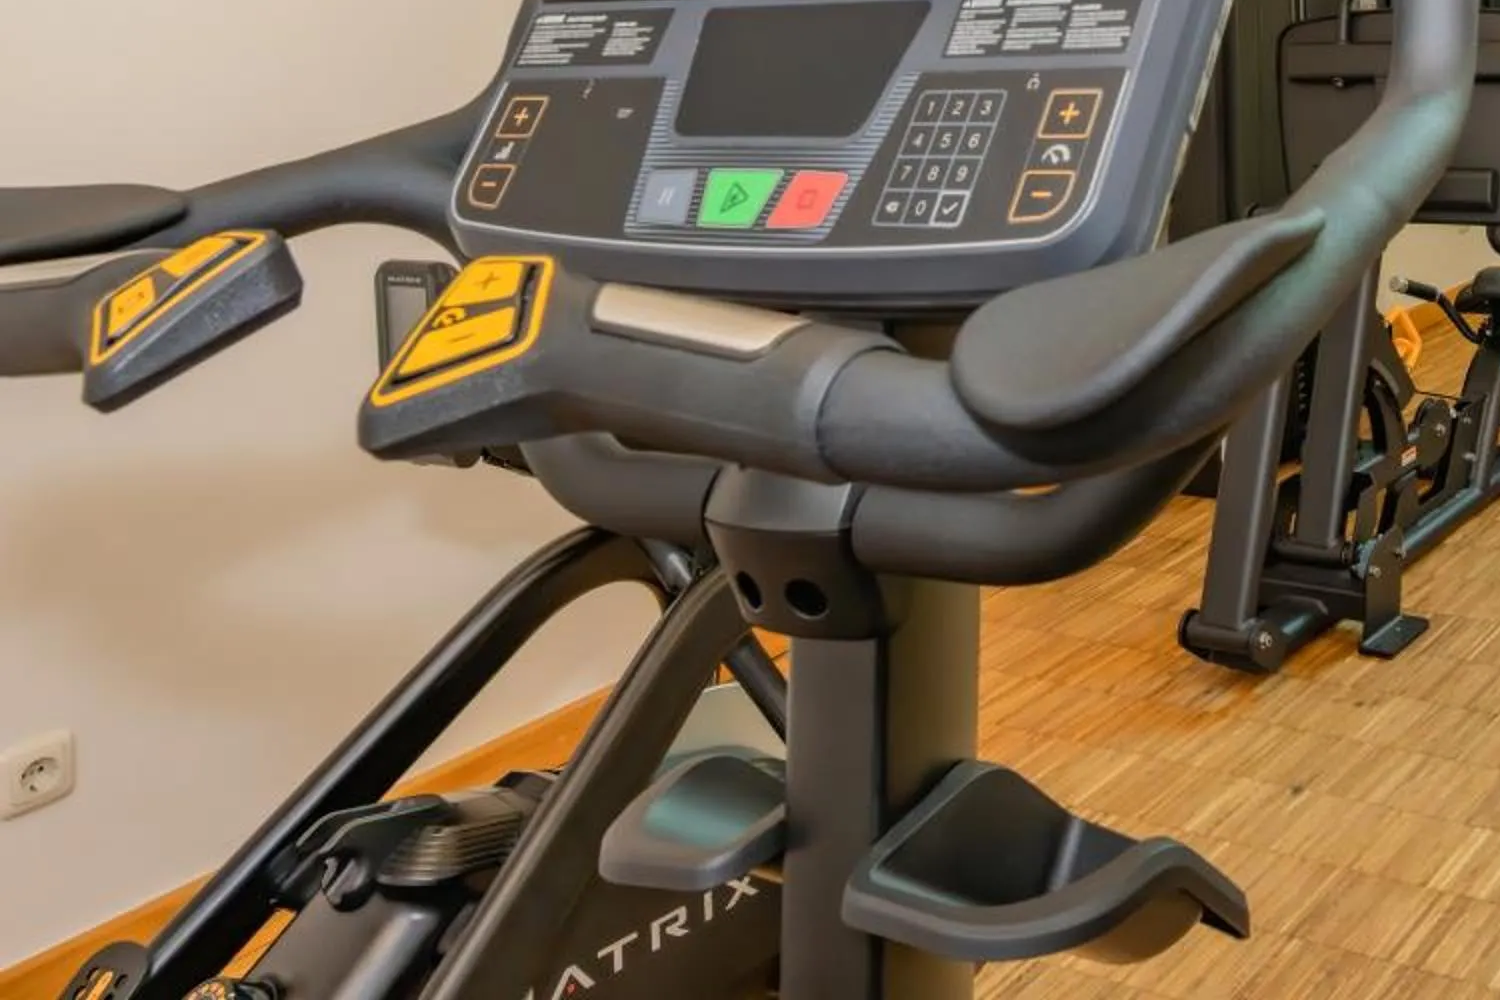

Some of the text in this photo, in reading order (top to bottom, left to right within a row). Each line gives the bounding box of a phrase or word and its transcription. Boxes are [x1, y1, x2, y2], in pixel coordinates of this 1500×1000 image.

[927, 100, 993, 115] 1 2 3
[912, 132, 981, 148] 4 5 6
[900, 165, 968, 182] 7 8 9
[915, 200, 927, 216] 0
[523, 876, 759, 1000] ATRIX
